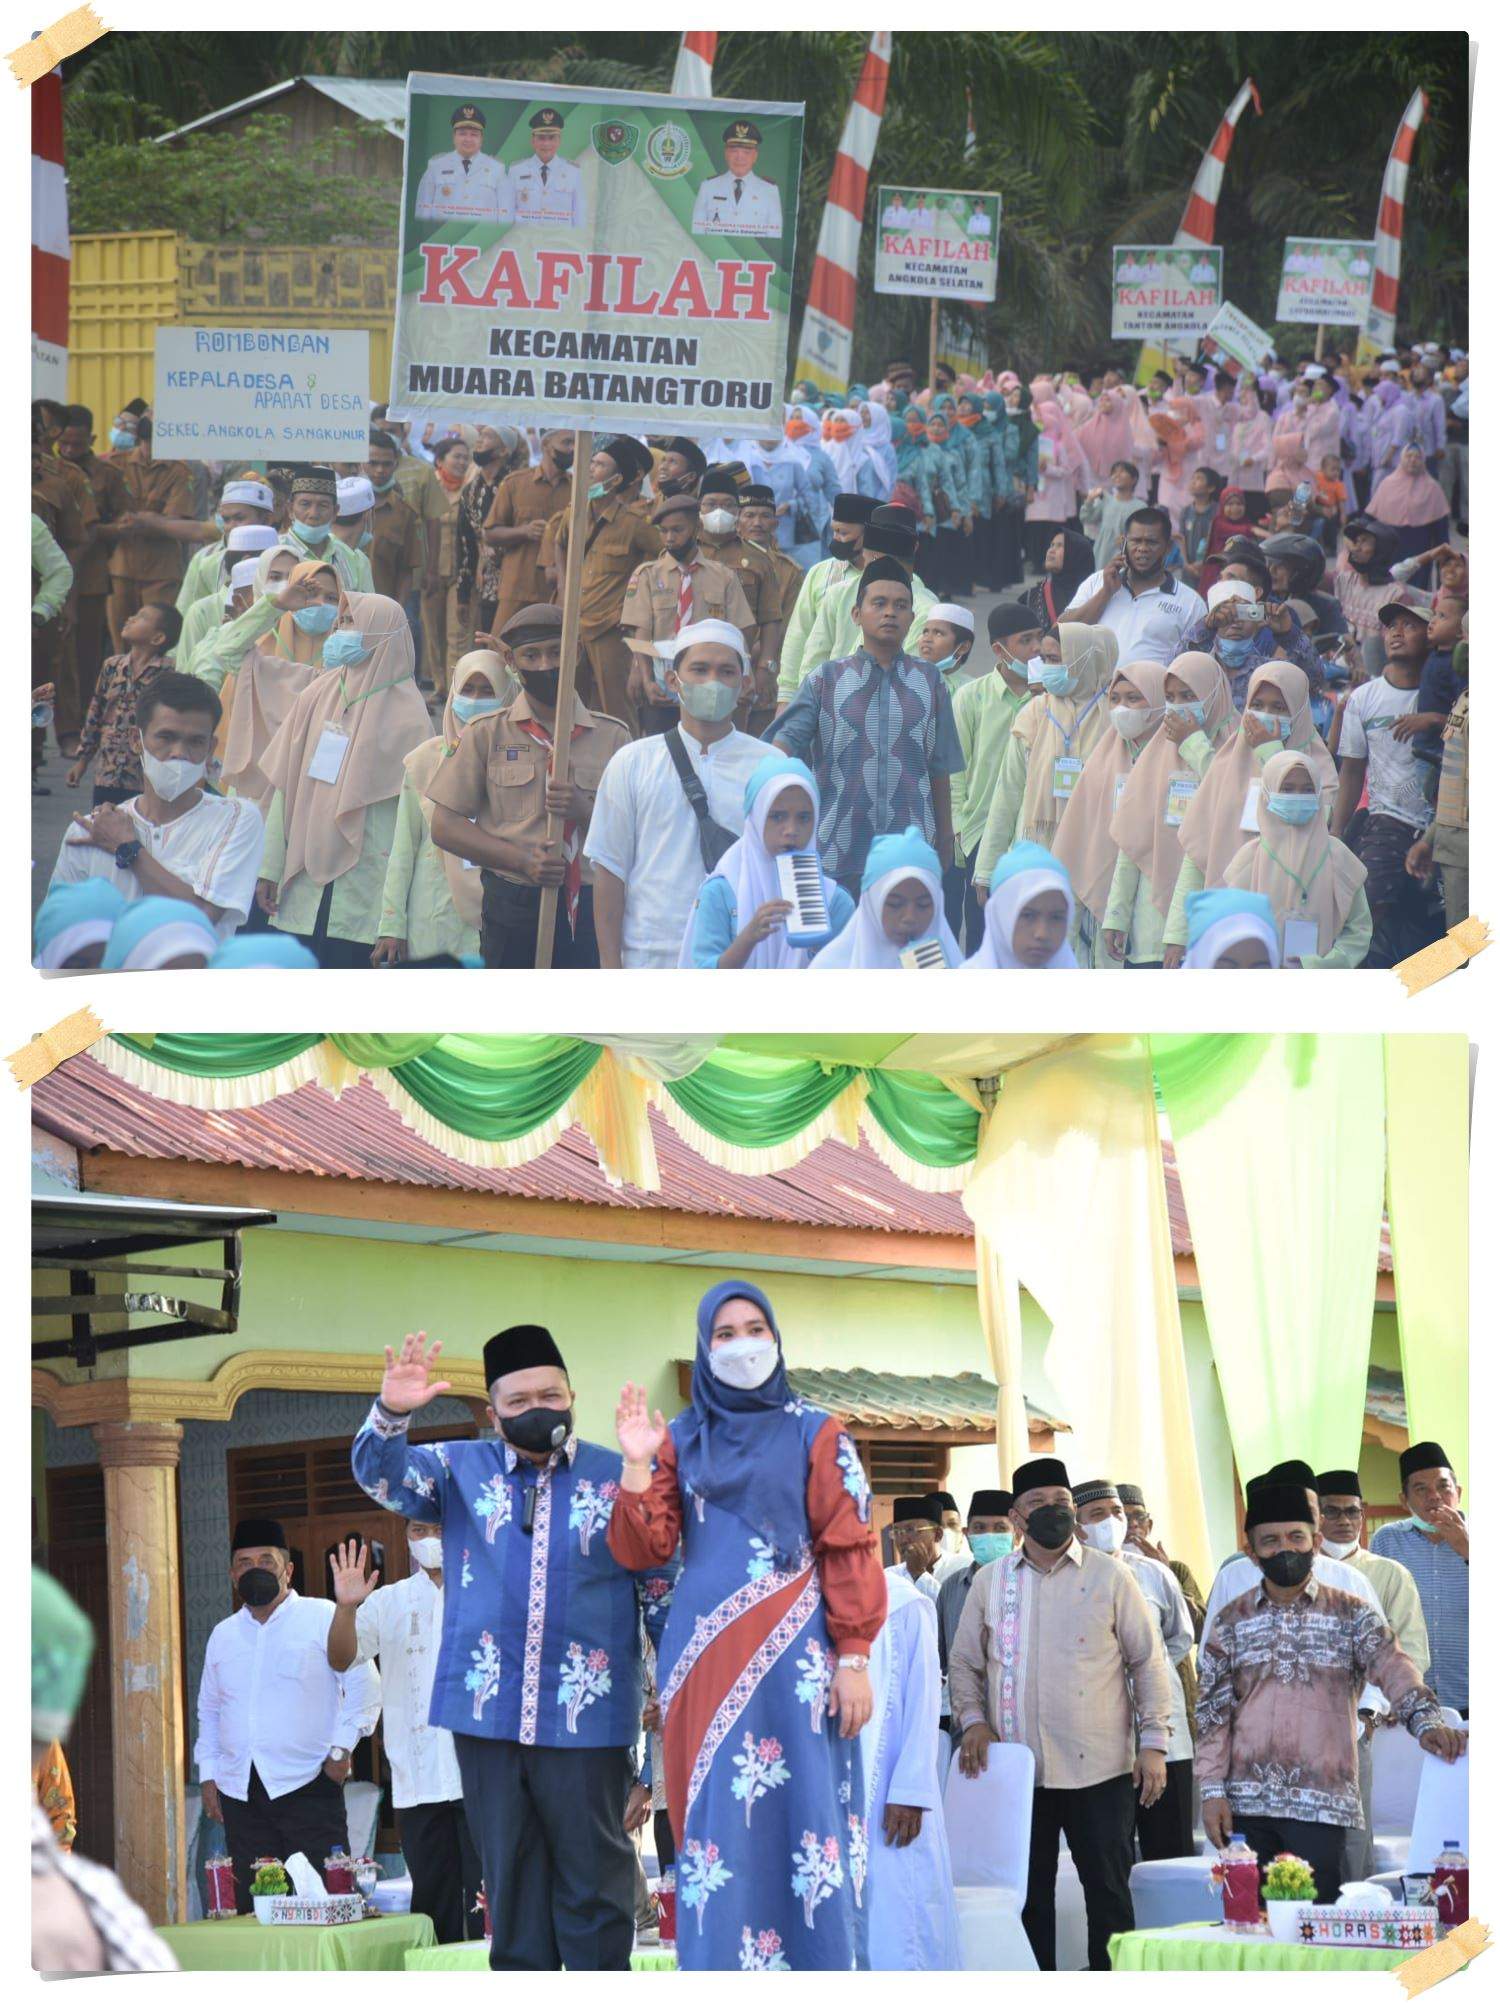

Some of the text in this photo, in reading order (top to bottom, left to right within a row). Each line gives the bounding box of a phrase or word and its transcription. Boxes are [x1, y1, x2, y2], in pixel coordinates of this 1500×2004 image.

[884, 236, 990, 261] KAFILAH
[905, 262, 968, 275] KECAMATAN
[419, 245, 774, 321] KAFILAH
[888, 274, 984, 289] ANGKOLA SELATAN
[1285, 277, 1367, 296] KAFILAH
[1119, 288, 1214, 307] KAFILAH
[1137, 311, 1195, 319] KECAMATAN
[195, 331, 330, 354] ROMBONGAN
[488, 328, 698, 366] KECAMATAN
[408, 364, 773, 410] MUARA BATANGTORU
[320, 393, 363, 411] DESA
[207, 423, 276, 440] ANGKOLA
[283, 426, 366, 441] SANGKUNUR
[1319, 1923, 1380, 1939] HORAS
